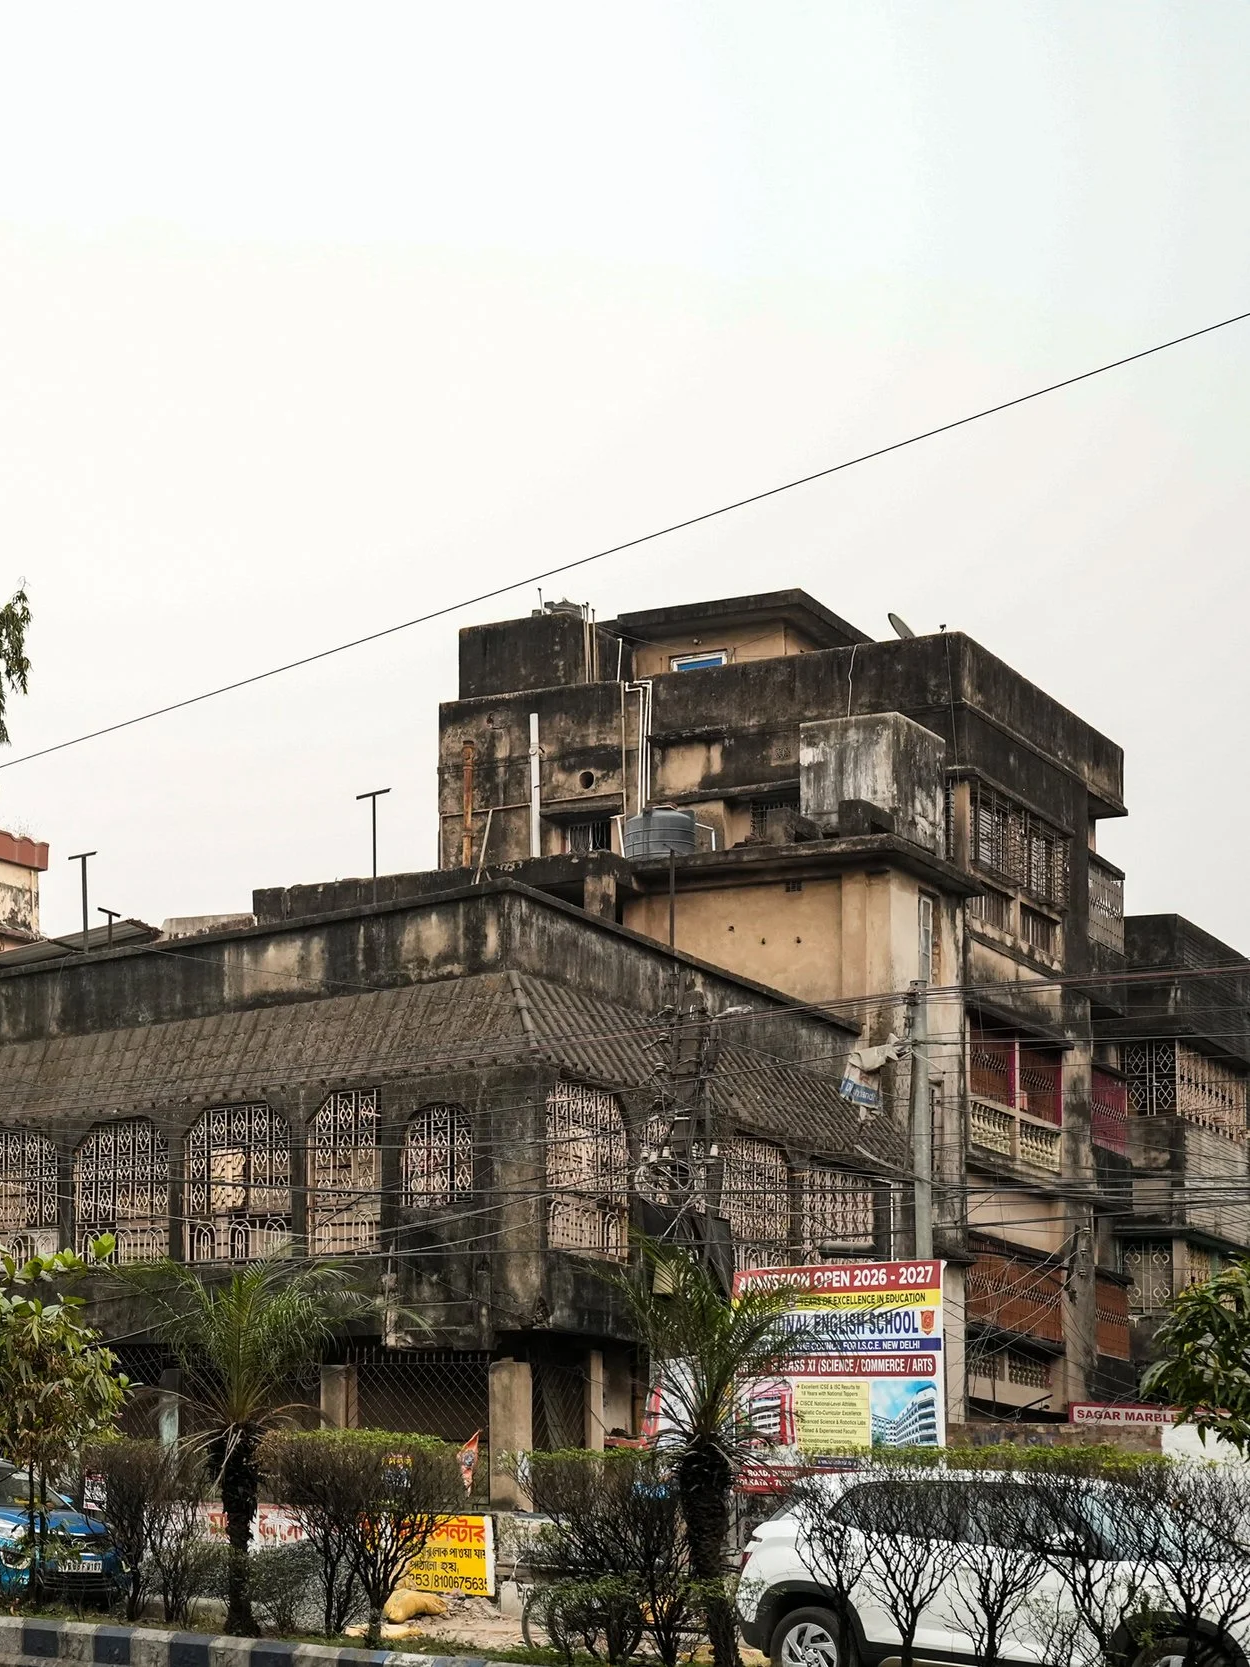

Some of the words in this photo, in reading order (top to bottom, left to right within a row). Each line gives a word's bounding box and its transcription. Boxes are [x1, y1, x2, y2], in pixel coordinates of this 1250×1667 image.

[814, 1271, 850, 1289] OPEN
[853, 1268, 887, 1286] 2026
[899, 1266, 933, 1285] 2027
[833, 1294, 877, 1305] EXCELLENCE
[878, 1294, 885, 1303] IN
[885, 1292, 926, 1303] EDUCATION
[814, 1312, 866, 1336] ENGLISH
[869, 1310, 919, 1335] SCHOOL
[842, 1341, 857, 1351] FOR
[858, 1340, 881, 1350] I.S.C.E.
[882, 1340, 898, 1350] NEW
[899, 1339, 920, 1350] DELHI
[780, 1358, 805, 1373] CLASS
[806, 1359, 816, 1372] XI
[817, 1357, 854, 1373] (SCIENCE
[862, 1357, 905, 1372] COMMERCE
[912, 1357, 933, 1372] ARTS
[1077, 1409, 1120, 1421] SAGAR
